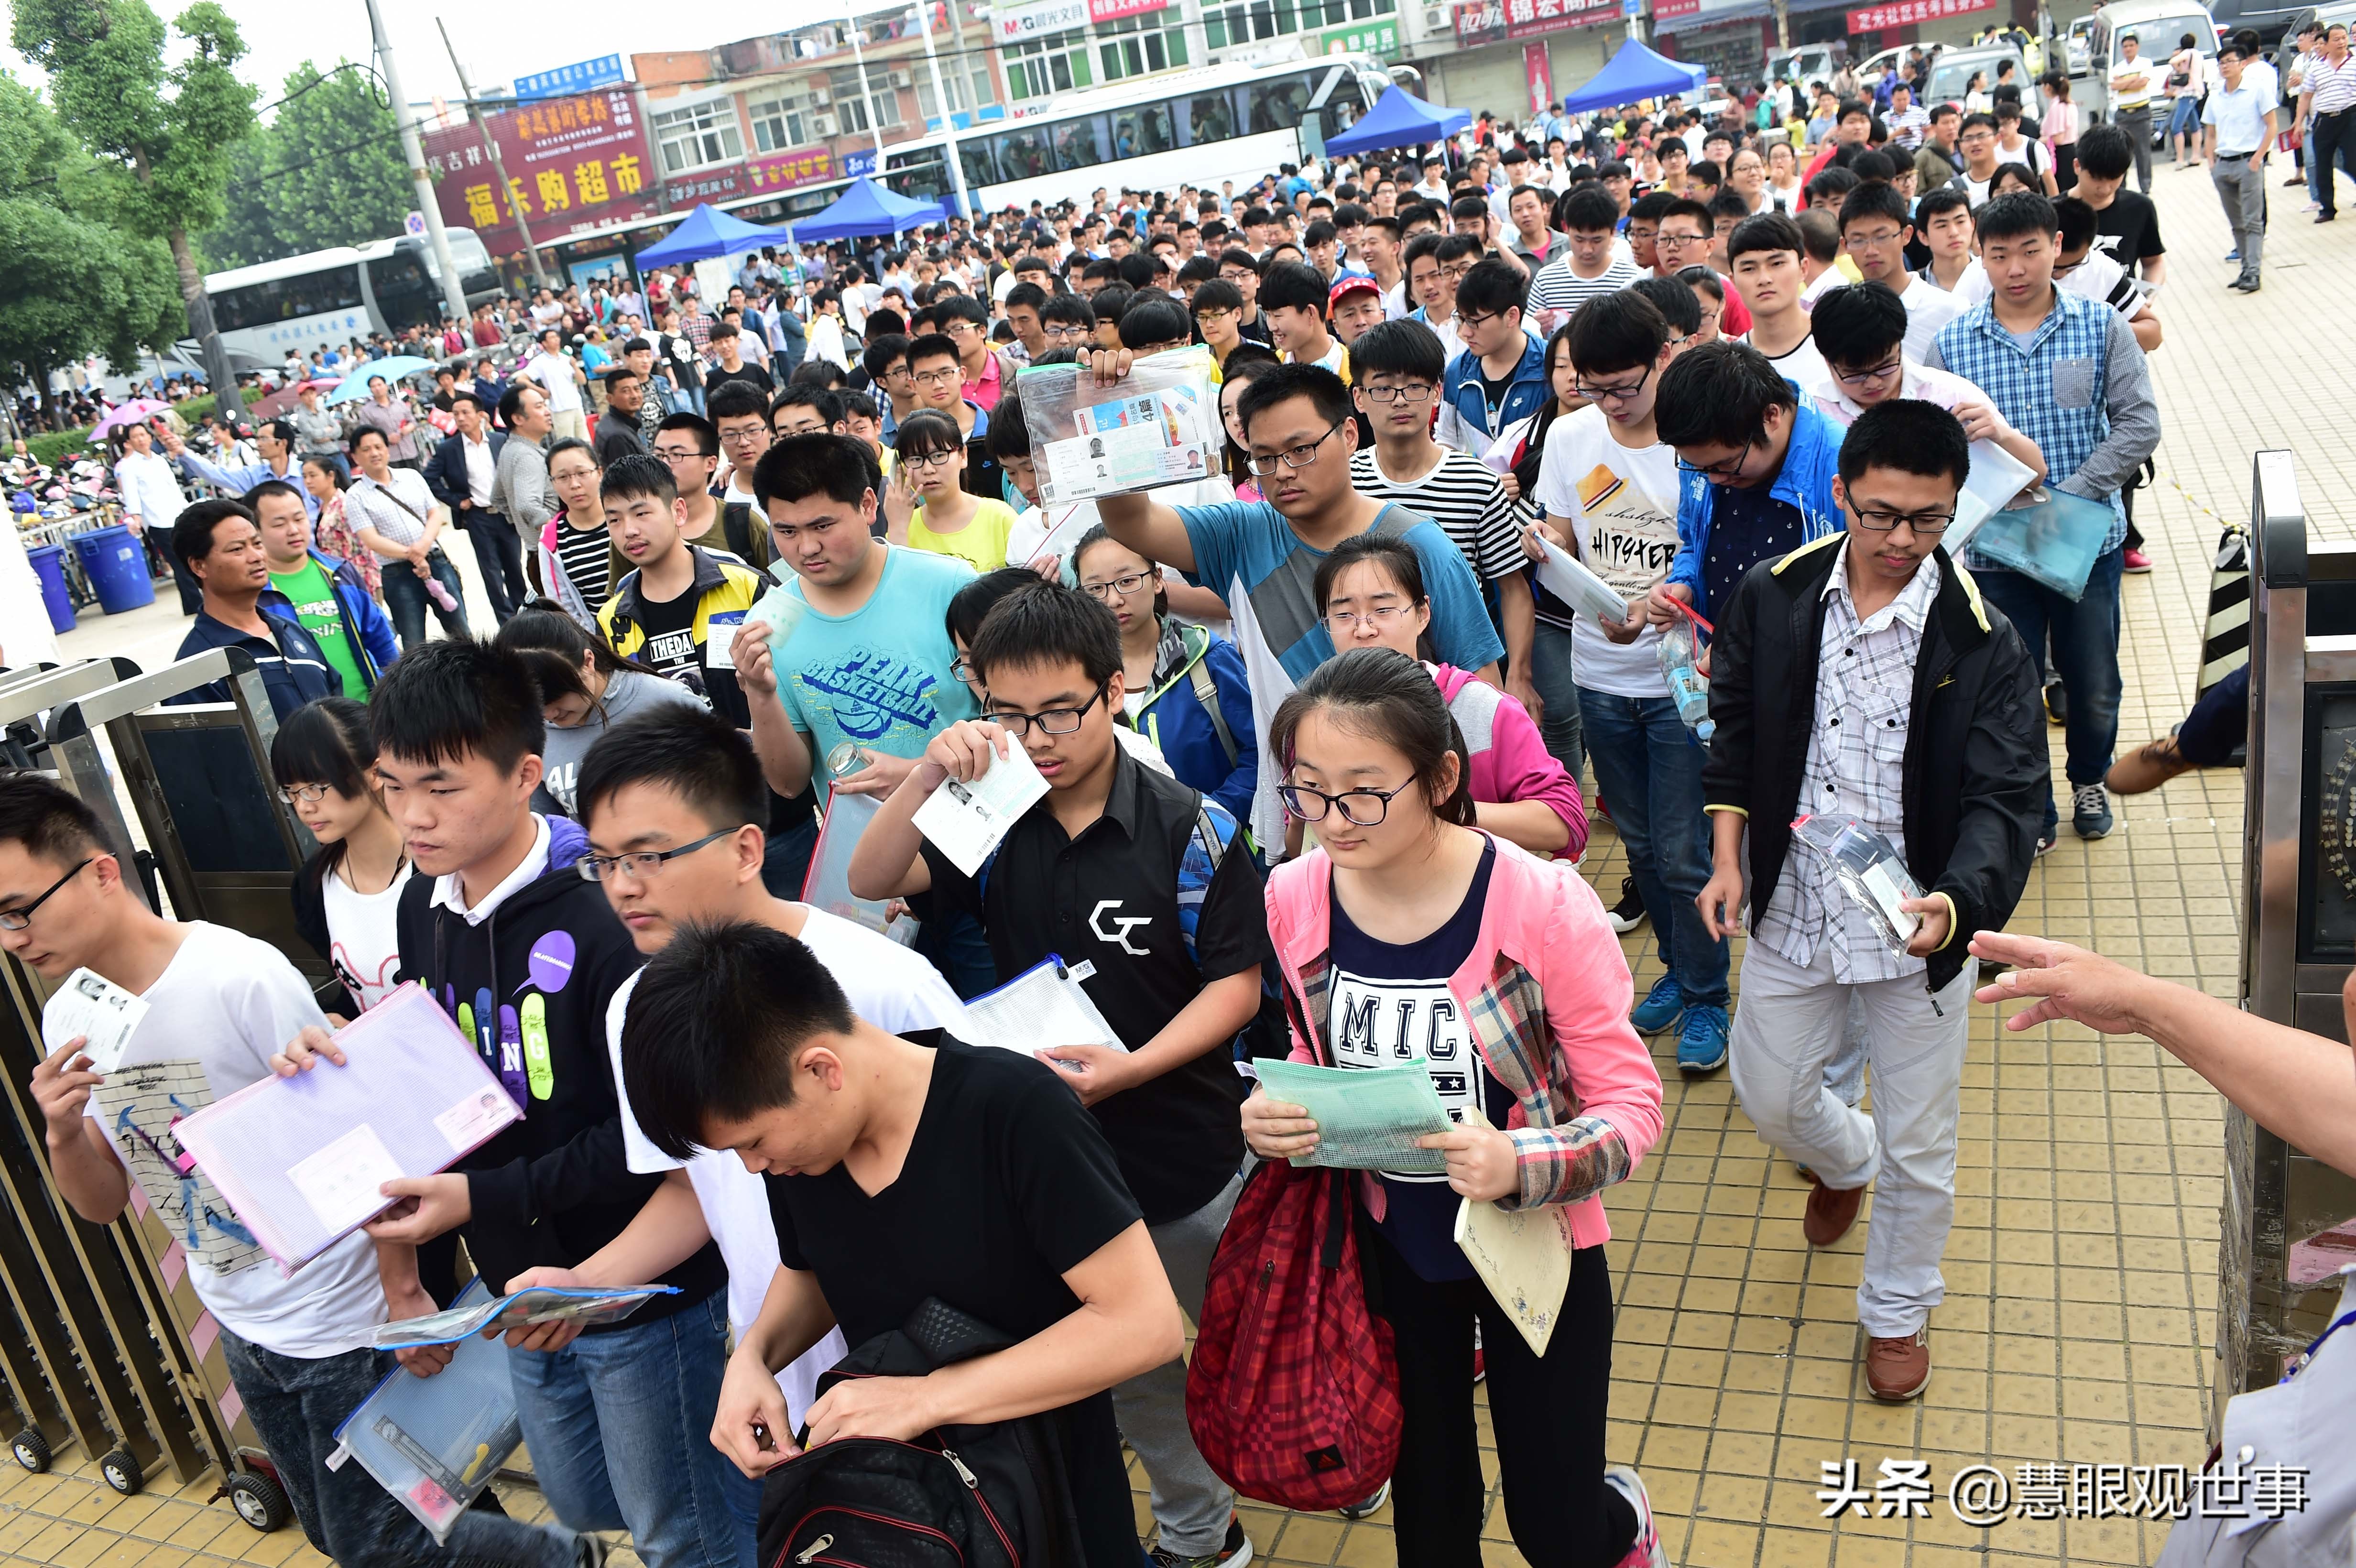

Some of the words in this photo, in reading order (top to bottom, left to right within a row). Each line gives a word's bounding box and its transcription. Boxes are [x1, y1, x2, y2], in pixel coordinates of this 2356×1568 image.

[1035, 4, 1084, 27] 晨光文具
[465, 152, 642, 228] 福乐购超市
[1592, 528, 1676, 574] HIPSTER
[674, 656, 685, 665] THE
[836, 644, 935, 699] PEAK
[802, 659, 935, 728] BASKETBALL
